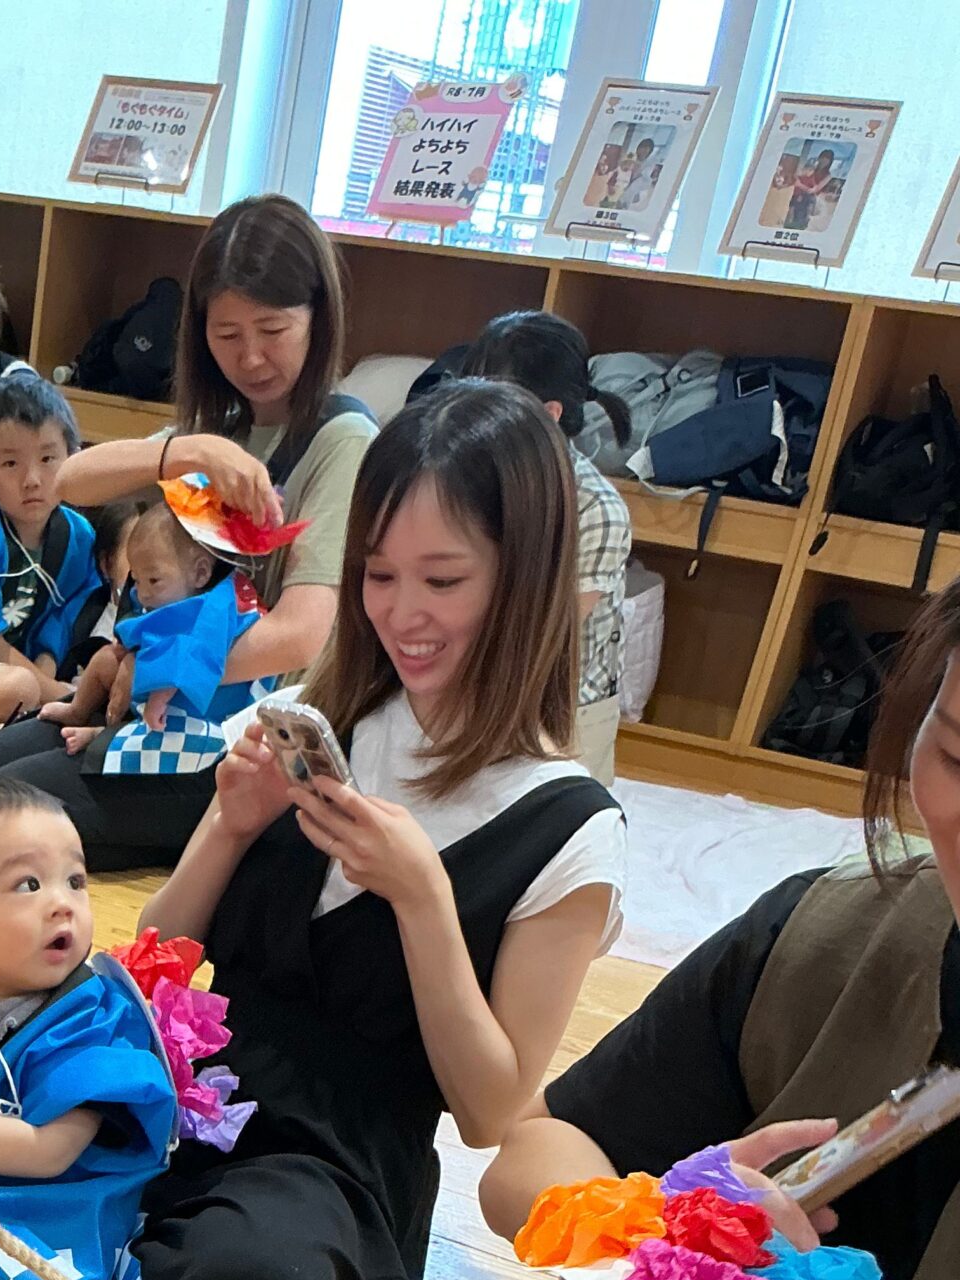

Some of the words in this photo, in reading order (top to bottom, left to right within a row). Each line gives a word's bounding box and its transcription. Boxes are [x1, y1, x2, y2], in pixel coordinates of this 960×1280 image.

[421, 118, 478, 134] ハイハイ
[412, 139, 470, 154] よちよち
[411, 159, 453, 176] レース
[393, 180, 457, 199] 結果発表
